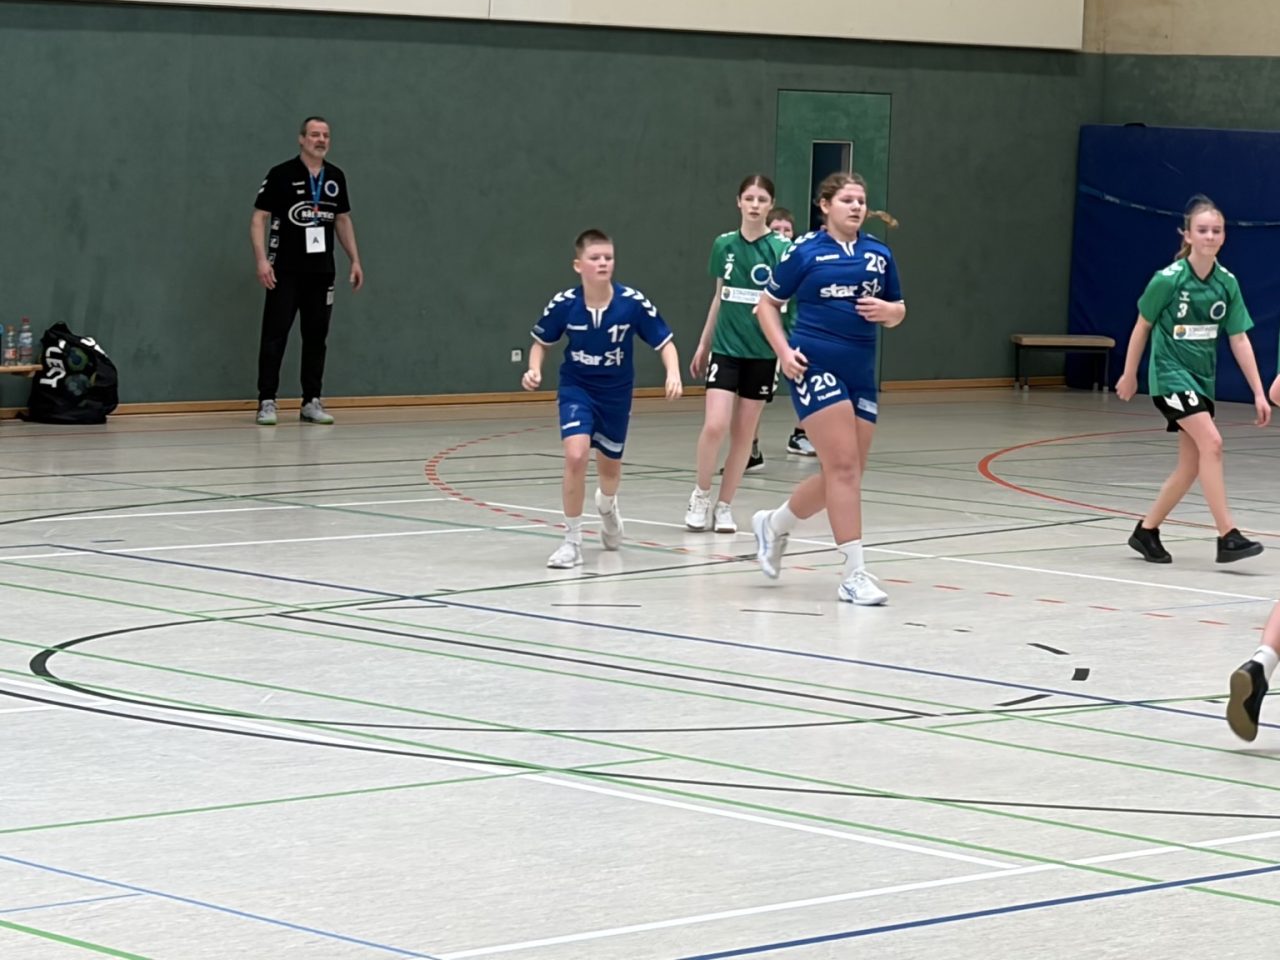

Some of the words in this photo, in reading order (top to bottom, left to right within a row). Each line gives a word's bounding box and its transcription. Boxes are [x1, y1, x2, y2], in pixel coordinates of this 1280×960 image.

[723, 263, 733, 280] 2
[864, 251, 887, 274] 20
[820, 283, 858, 298] star
[1177, 302, 1188, 318] 3
[607, 323, 631, 343] 17
[570, 350, 603, 366] star
[708, 363, 718, 382] 2
[810, 372, 837, 392] 20
